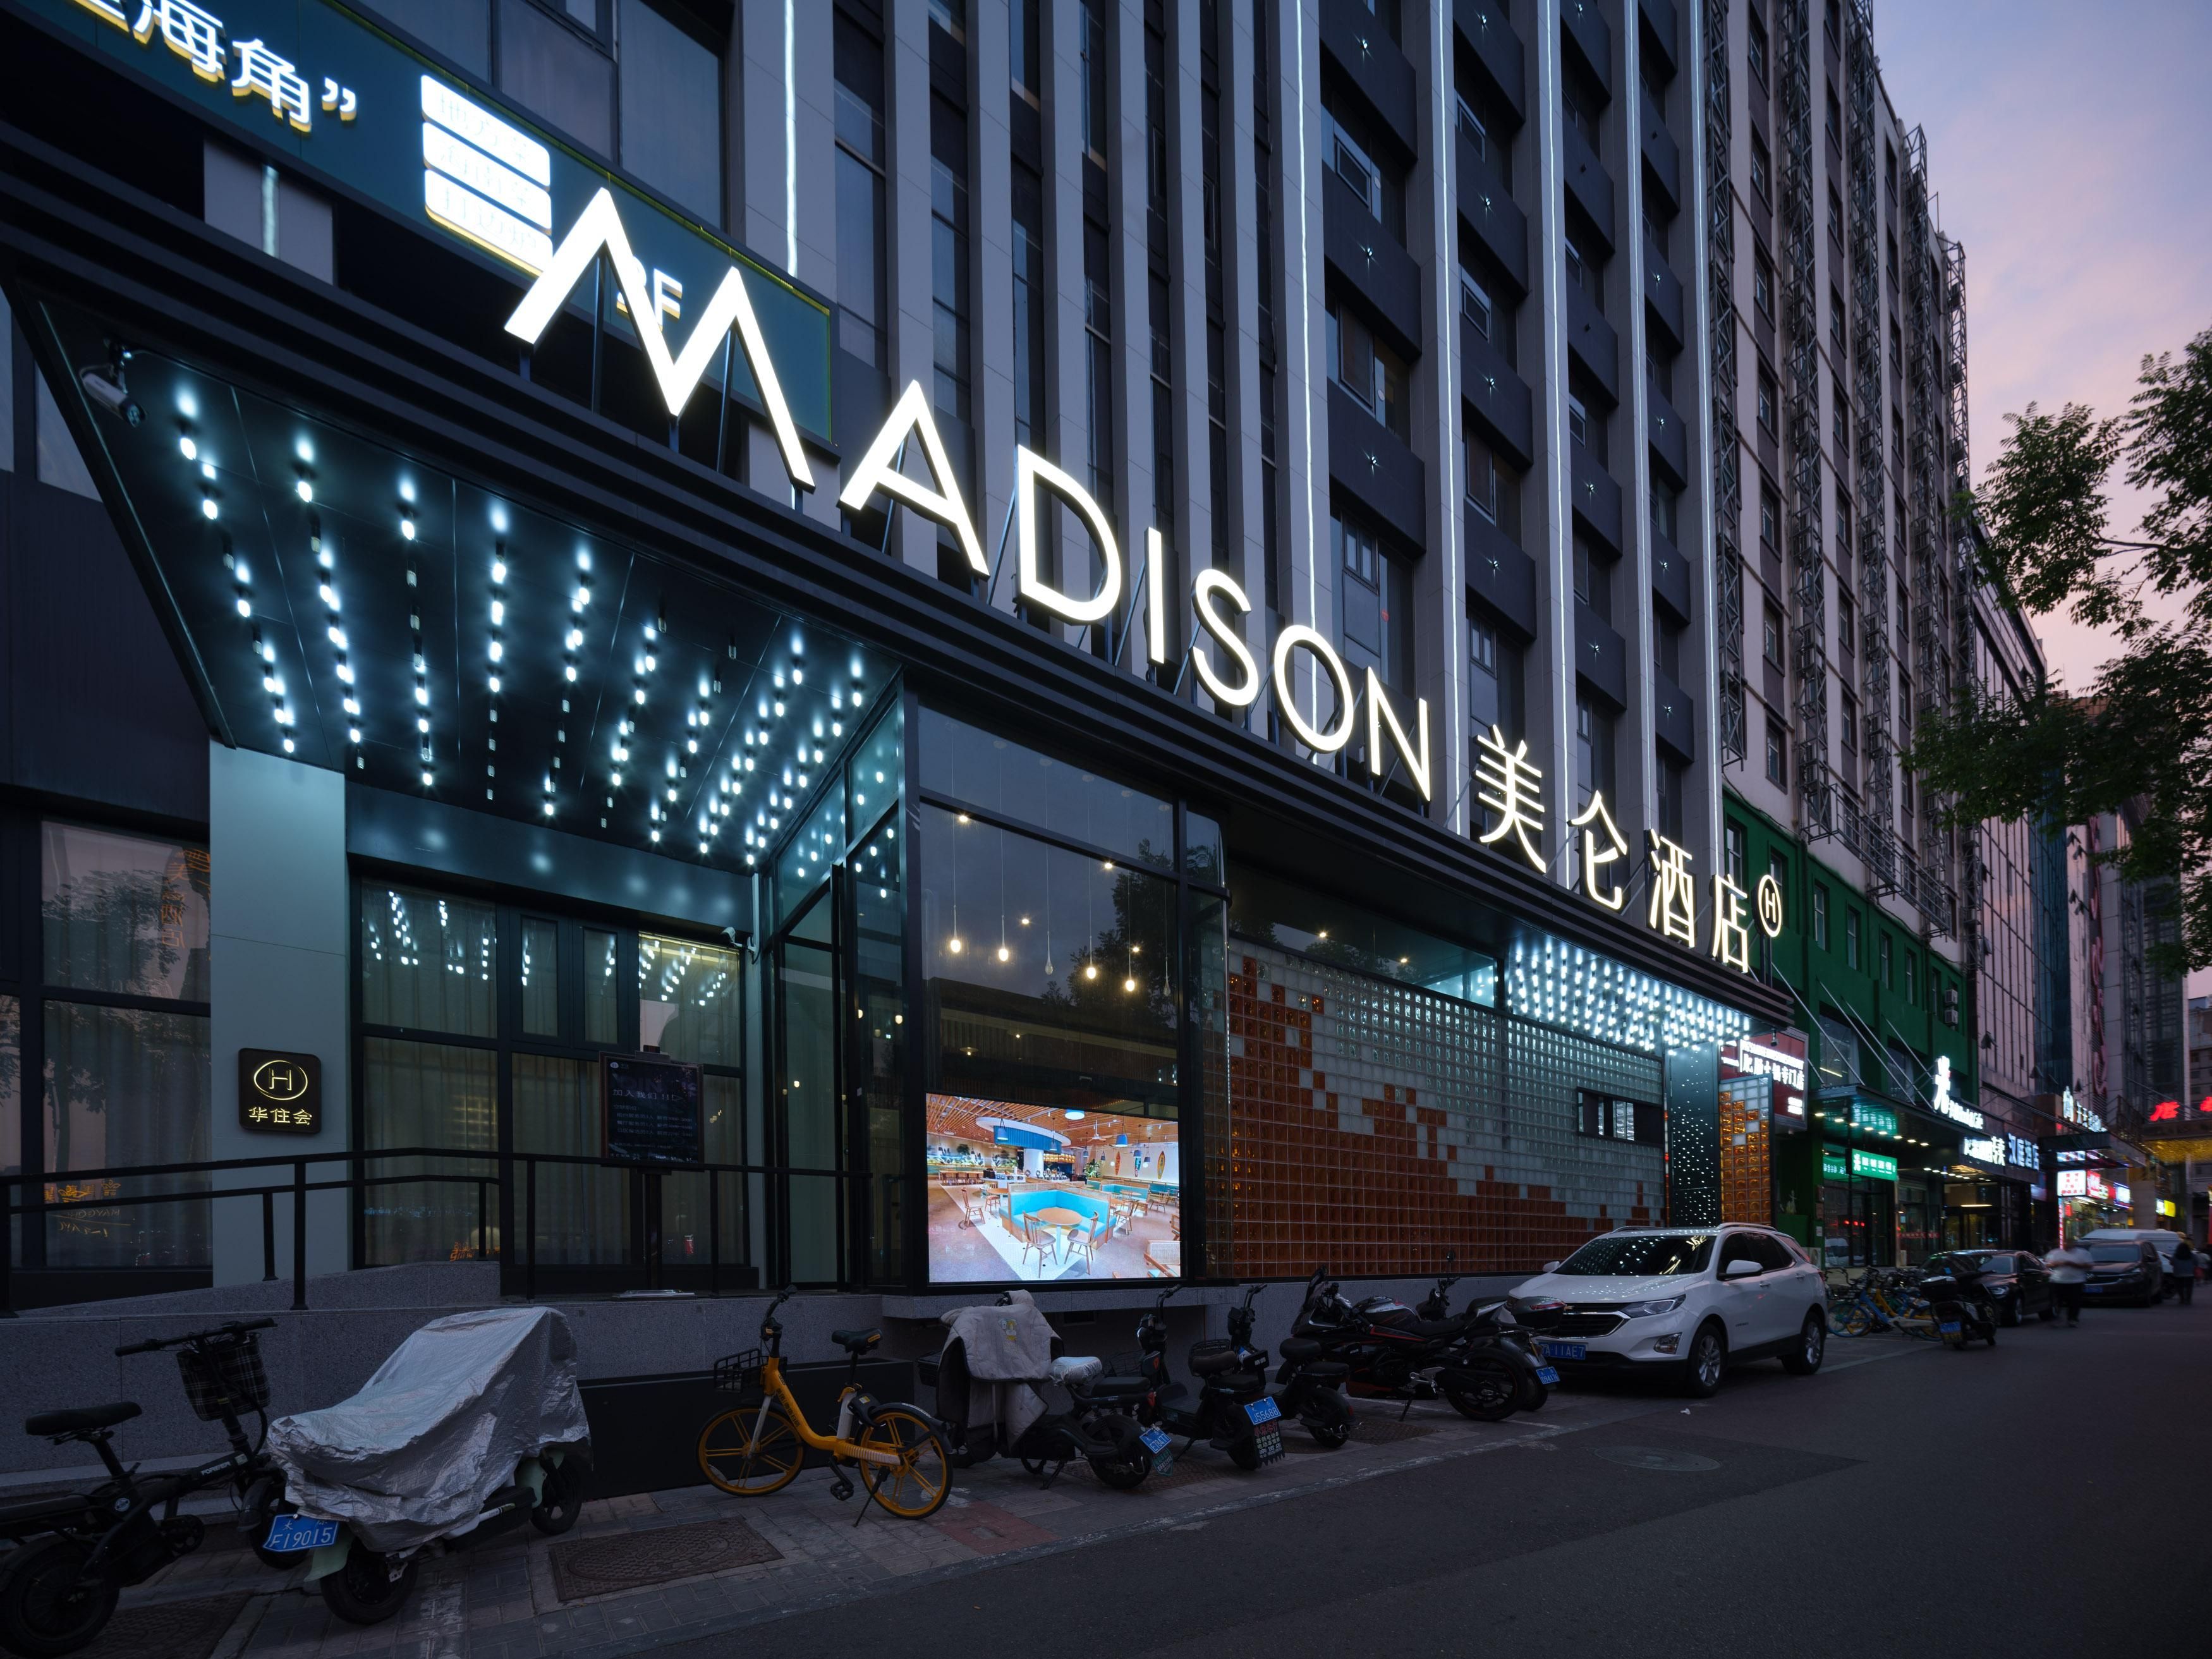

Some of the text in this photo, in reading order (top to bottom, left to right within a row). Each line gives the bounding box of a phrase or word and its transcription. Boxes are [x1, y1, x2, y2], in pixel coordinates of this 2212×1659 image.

[71, 0, 356, 131] 海角”
[506, 188, 1430, 801] MADISON
[1475, 724, 1749, 974] 美仑酒店
[612, 1089, 657, 1100] 加入我们
[248, 1106, 313, 1126] 华住会
[2008, 1133, 2039, 1171] 汉庭酒店
[1253, 1407, 1279, 1423] J55688
[269, 1527, 334, 1549] F19015
